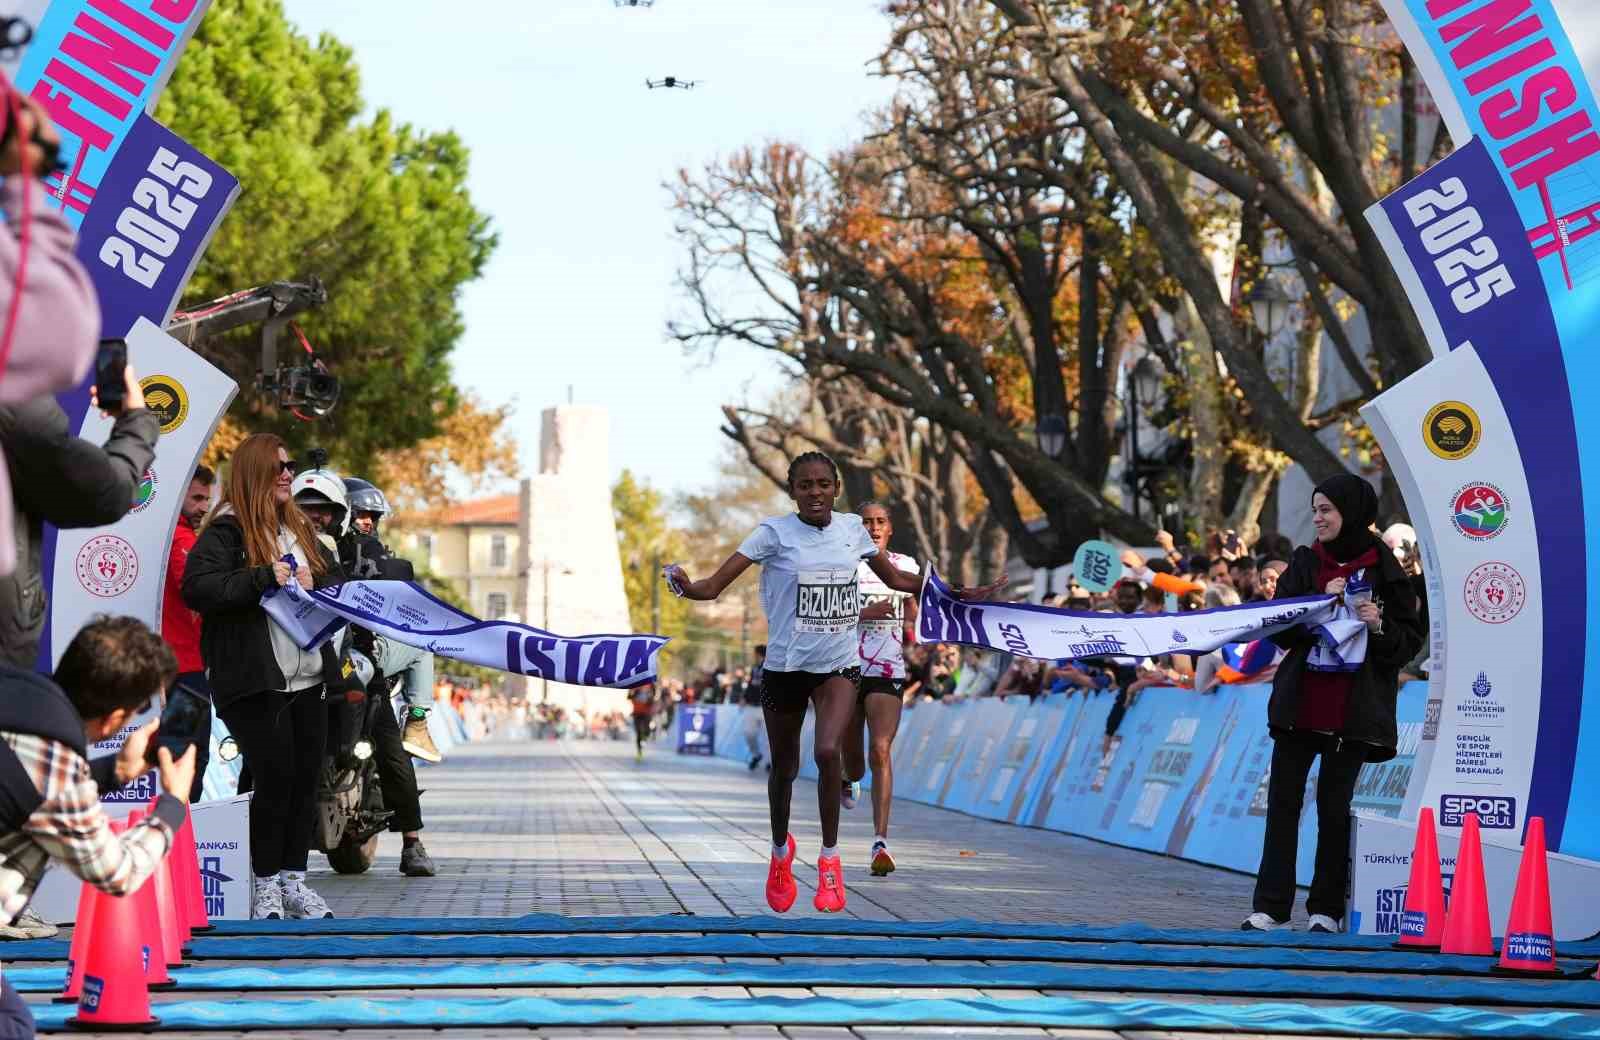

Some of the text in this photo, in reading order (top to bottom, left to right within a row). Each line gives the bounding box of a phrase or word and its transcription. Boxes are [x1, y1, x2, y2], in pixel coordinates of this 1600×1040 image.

[99, 146, 213, 289] 2025
[1403, 176, 1516, 314] 2025
[1456, 734, 1491, 743] GENÇLİK
[1456, 750, 1502, 759] HİZMETLERİ
[1456, 758, 1487, 766] DAİRESİ
[1456, 766, 1504, 775] BAŞKANLIĞI
[1444, 797, 1511, 815] SPOR
[1363, 852, 1409, 865] TÜRKİYE
[1508, 945, 1552, 957] TIMING
